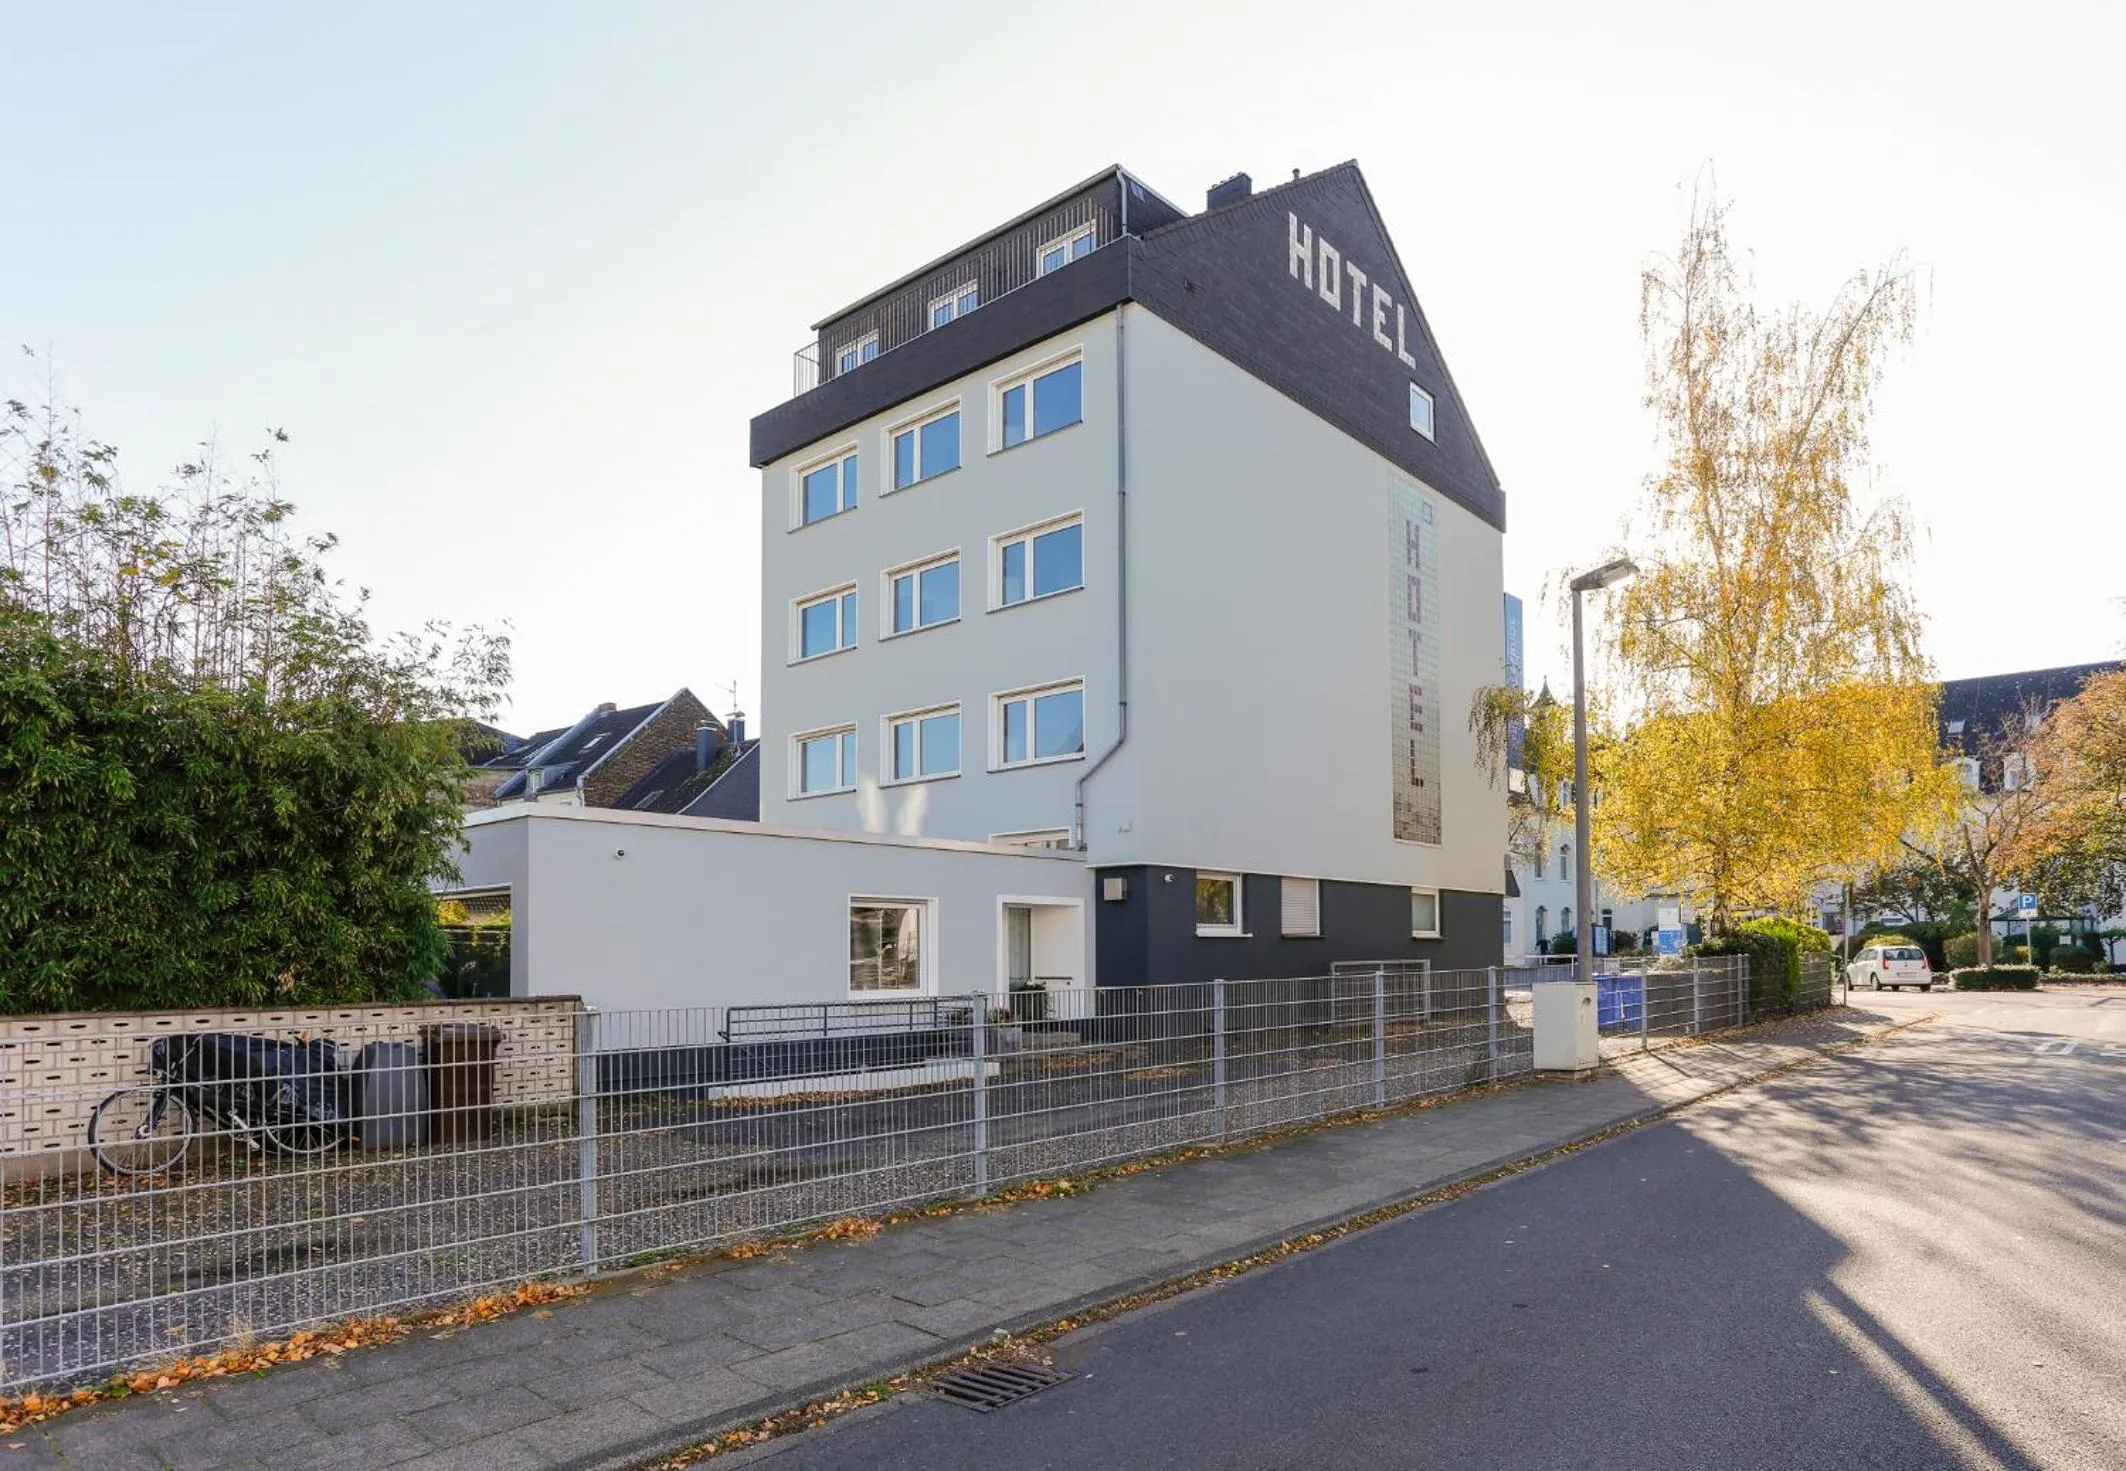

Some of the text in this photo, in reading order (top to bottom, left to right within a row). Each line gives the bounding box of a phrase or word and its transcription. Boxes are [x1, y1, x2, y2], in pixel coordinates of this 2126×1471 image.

[1289, 212, 1416, 369] HOTEL
[1405, 519, 1424, 788] HOTEL
[2022, 895, 2033, 907] P
